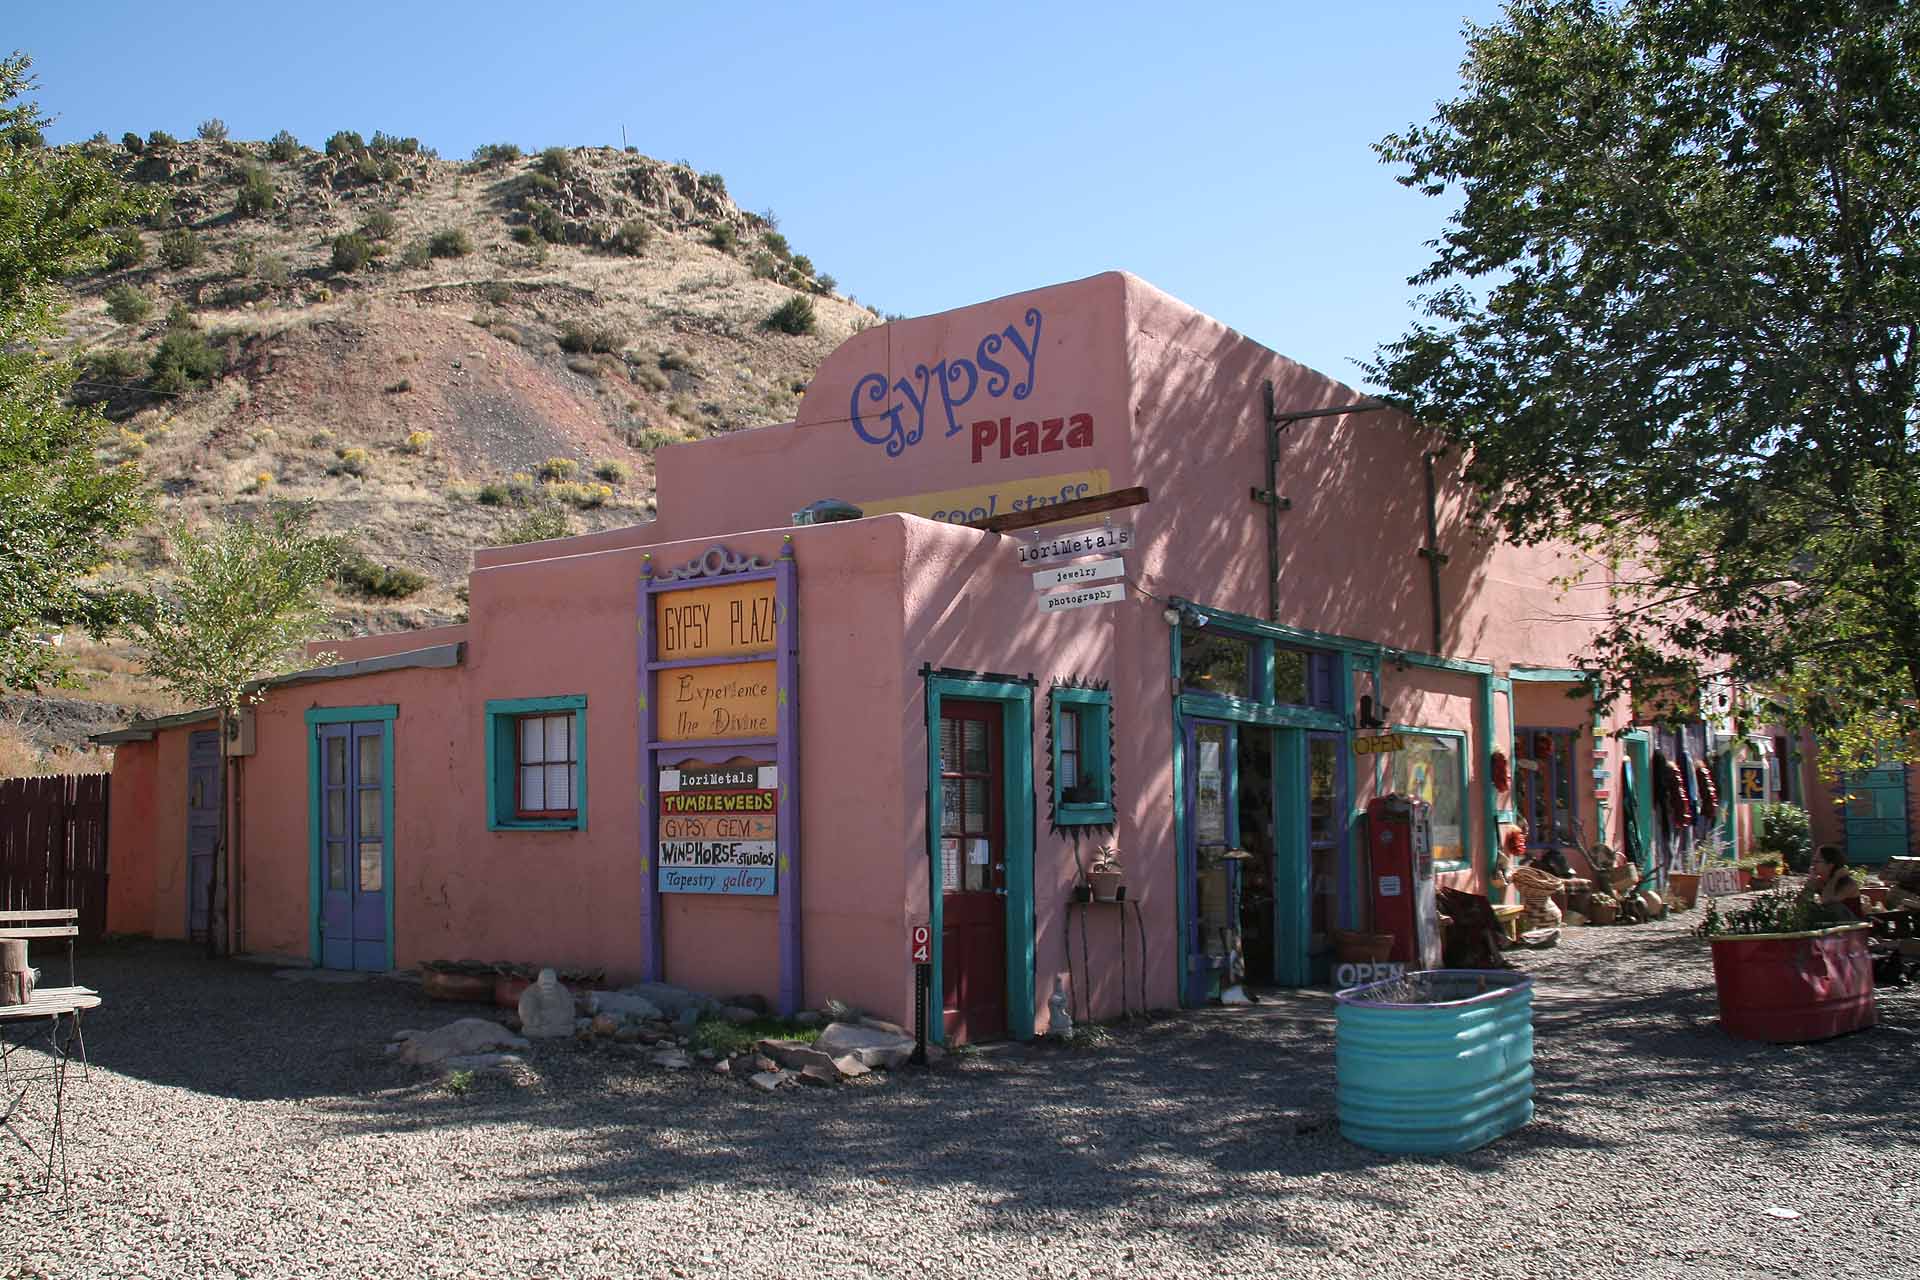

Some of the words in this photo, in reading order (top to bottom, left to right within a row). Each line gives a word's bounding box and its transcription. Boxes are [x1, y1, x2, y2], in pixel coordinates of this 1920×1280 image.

[850, 307, 1042, 457] Gypsy
[970, 412, 1094, 463] Plaza
[1019, 531, 1129, 562] loriMetals
[1056, 567, 1097, 582] jewelry
[1048, 590, 1112, 608] photography
[665, 604, 710, 650] GYPSY
[730, 594, 777, 646] PLAZA
[676, 674, 768, 711] Experience
[677, 712, 699, 735] the
[712, 707, 768, 735] Divine
[1355, 735, 1403, 754] OPEN
[681, 771, 753, 786] loriMetals
[665, 792, 773, 812] TUMBLEWEEDS
[665, 819, 709, 838] GYPSY
[716, 819, 751, 837] GEM
[666, 871, 715, 890] Tapestry
[722, 869, 766, 892] gallery
[1706, 870, 1741, 892] OPEN
[1338, 963, 1404, 987] OPEN
